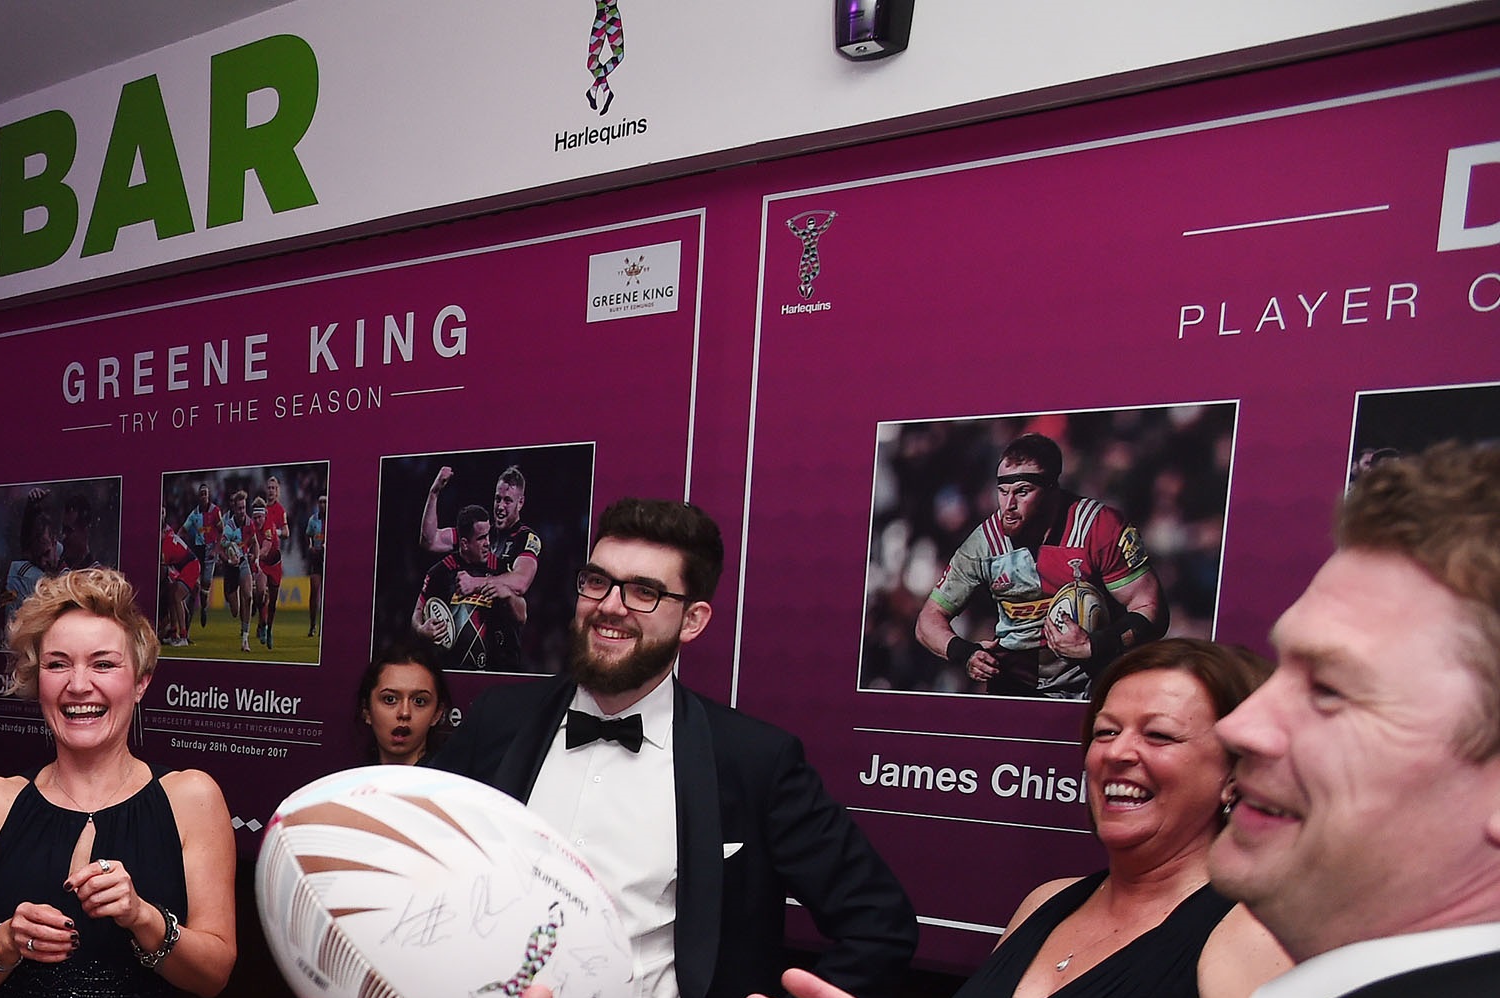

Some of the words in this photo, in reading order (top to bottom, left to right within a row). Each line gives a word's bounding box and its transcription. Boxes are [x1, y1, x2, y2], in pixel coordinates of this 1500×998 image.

[554, 116, 647, 151] Harlequins
[592, 291, 638, 308] GREENE
[643, 286, 674, 301] KING
[781, 300, 831, 315] Harlequins
[1178, 282, 1418, 339] PLAYER
[62, 333, 269, 404] GREENE
[308, 304, 469, 374] KING
[118, 409, 158, 434] TRY
[171, 406, 200, 430] OF
[213, 398, 260, 424] THE
[274, 385, 384, 418] SEASON
[166, 684, 229, 710] Charlie
[235, 688, 302, 715] Walker
[152, 715, 192, 726] WORCESTER
[194, 720, 231, 730] WARRIORS
[234, 722, 243, 730] AT
[245, 723, 294, 735] TWICKENHAM
[297, 727, 323, 737] STOOP
[171, 738, 207, 752] Saturday
[209, 741, 228, 752] 28th
[230, 743, 265, 757] October
[267, 747, 288, 758] 2017
[859, 754, 978, 797] James
[532, 866, 589, 918] Harlequins
